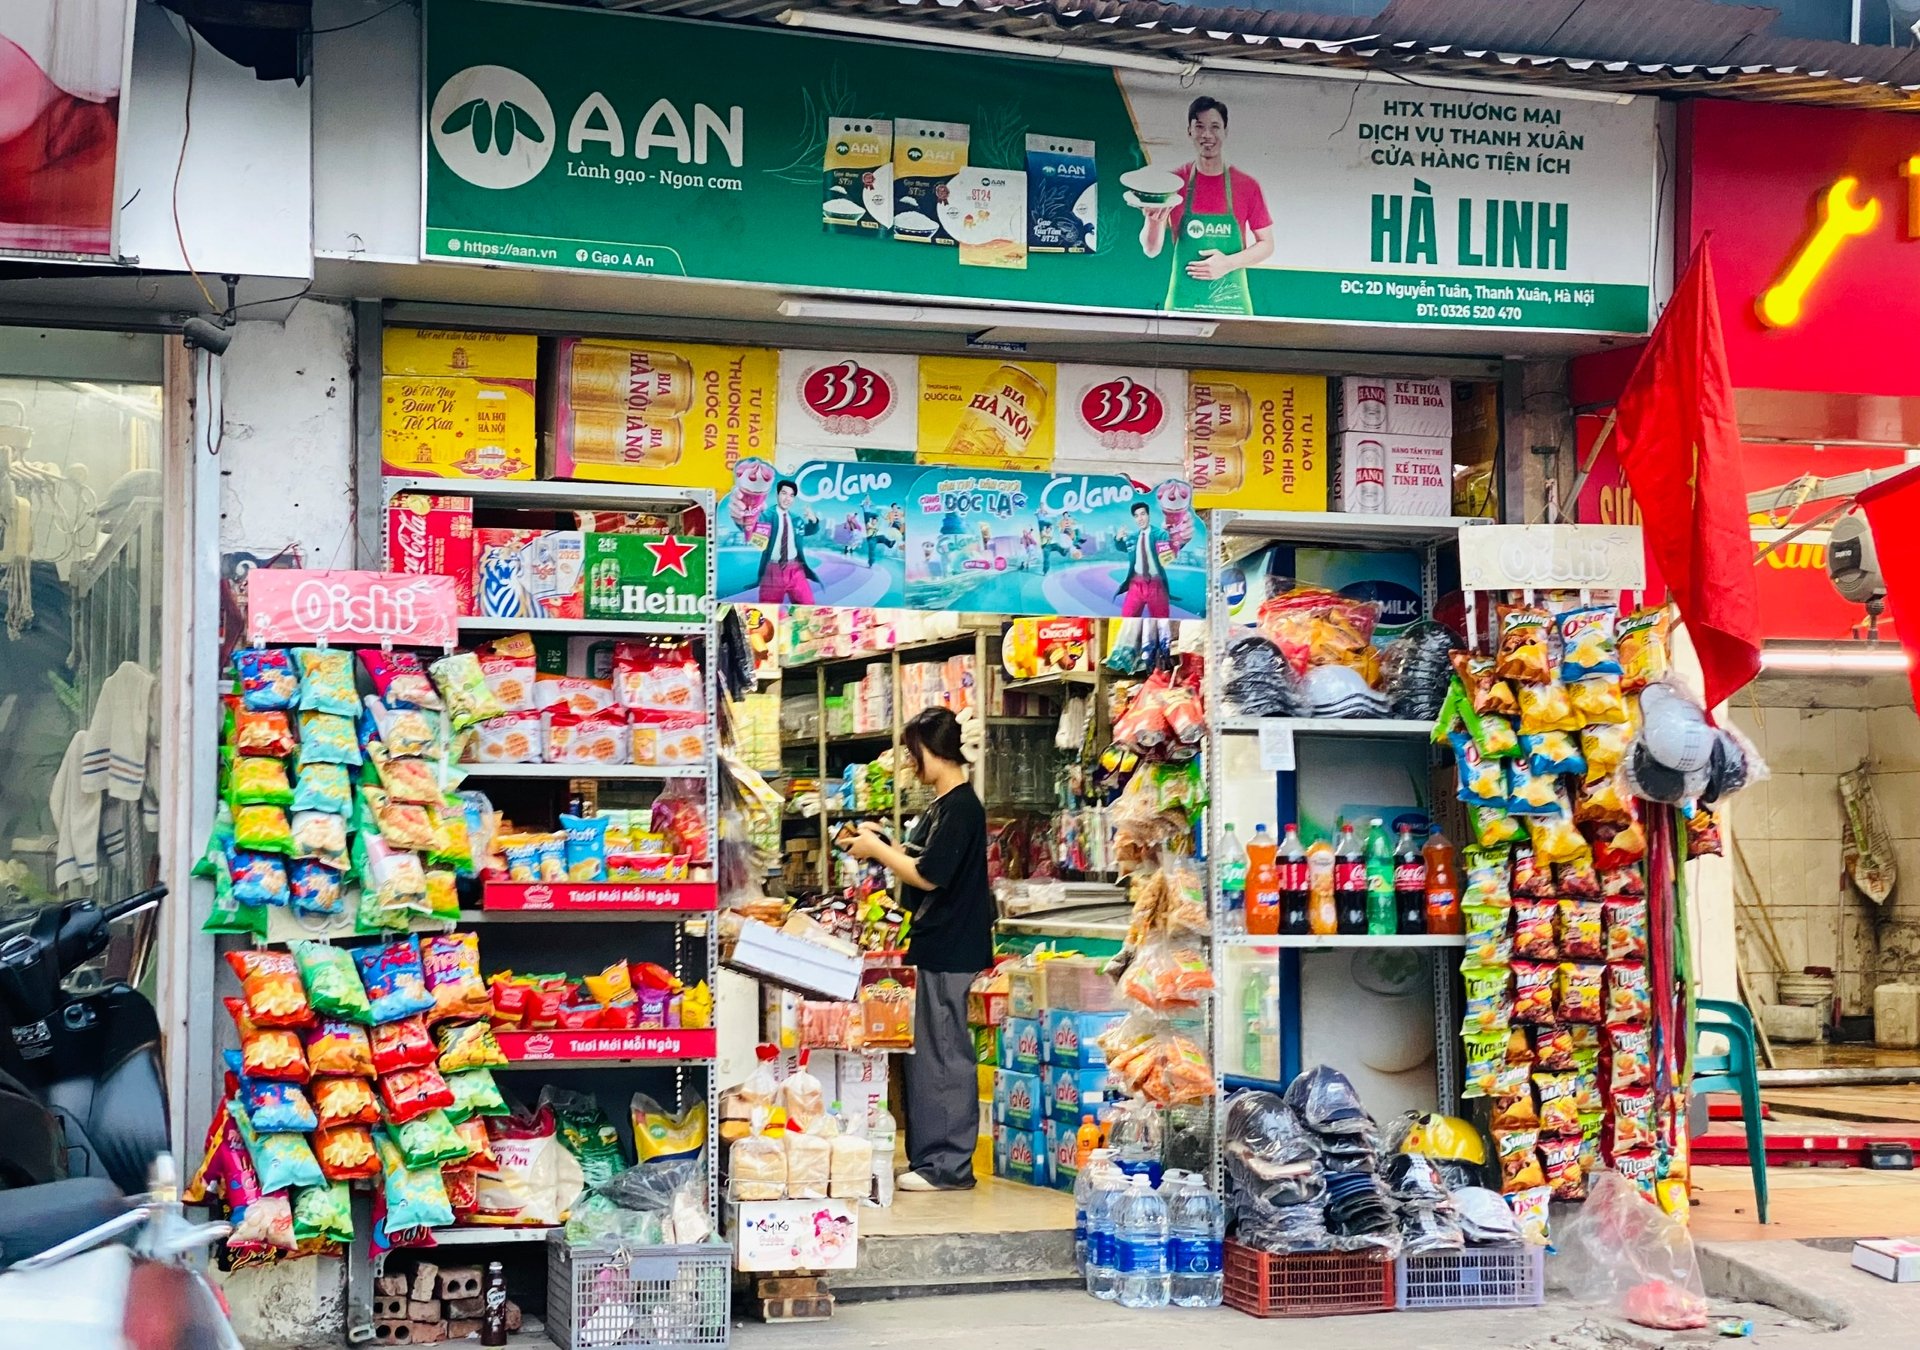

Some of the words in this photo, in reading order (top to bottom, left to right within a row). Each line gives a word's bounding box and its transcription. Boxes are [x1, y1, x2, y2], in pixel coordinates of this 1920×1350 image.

[1384, 100, 1424, 118] HTX
[1430, 102, 1517, 121] THƯƠNG
[1523, 106, 1561, 128] MẠI
[1359, 123, 1408, 143] DỊCH
[1415, 127, 1443, 144] VỤ
[1450, 129, 1521, 146] THANH
[1527, 130, 1584, 150] XUÂN
[1371, 145, 1415, 167] CỬA
[1421, 149, 1480, 170] HÀNG
[1484, 151, 1531, 176] TIỆN
[1536, 153, 1570, 175] ÍCH
[567, 161, 610, 180] Lành
[614, 168, 645, 185] gạo
[660, 170, 704, 189] Ngon
[707, 176, 743, 190] cơm
[1371, 177, 1438, 265] HÀ
[1458, 197, 1568, 270] LINH
[464, 240, 557, 260] https://aan.vn
[591, 250, 619, 267] Gạo
[622, 254, 635, 265] A
[635, 255, 654, 267] An
[1340, 279, 1363, 294] ĐC:
[1366, 281, 1383, 295] 2D
[1386, 279, 1435, 300] Nguyễn
[1474, 284, 1513, 300] Thanh
[1516, 286, 1552, 303] Xuân,
[1555, 287, 1570, 302] Hà
[1573, 288, 1594, 305] Nội
[1416, 304, 1439, 318] ĐT:
[1441, 305, 1471, 318] 0326
[1473, 306, 1495, 319] 520
[1498, 307, 1522, 320] 470
[630, 352, 655, 376] HÀ
[624, 380, 653, 412] NỘI
[657, 372, 671, 396] BIA
[1001, 385, 1025, 407] BIA
[1396, 381, 1409, 393] KẾ
[1194, 386, 1217, 408] HÀ
[1393, 394, 1419, 405] TINH
[1423, 397, 1445, 408] HOA
[968, 393, 998, 416] HÀ
[1000, 405, 1032, 440] NỘI
[1219, 403, 1231, 426] BIA
[650, 428, 662, 448] BIA
[704, 424, 718, 450] GIA
[1215, 457, 1226, 476] BIA
[1262, 449, 1275, 476] GIA
[1395, 462, 1409, 474] KẾ
[796, 462, 892, 502] Celano
[1392, 475, 1418, 486] TINH
[1422, 476, 1444, 487] HOA
[1041, 476, 1133, 515] Celano
[1500, 536, 1612, 582] Oishi
[292, 579, 417, 635] Oishi
[1380, 600, 1417, 614] MILK
[599, 1038, 622, 1051] Mới
[623, 1034, 646, 1051] Mỗi
[648, 1037, 681, 1053] Ngày
